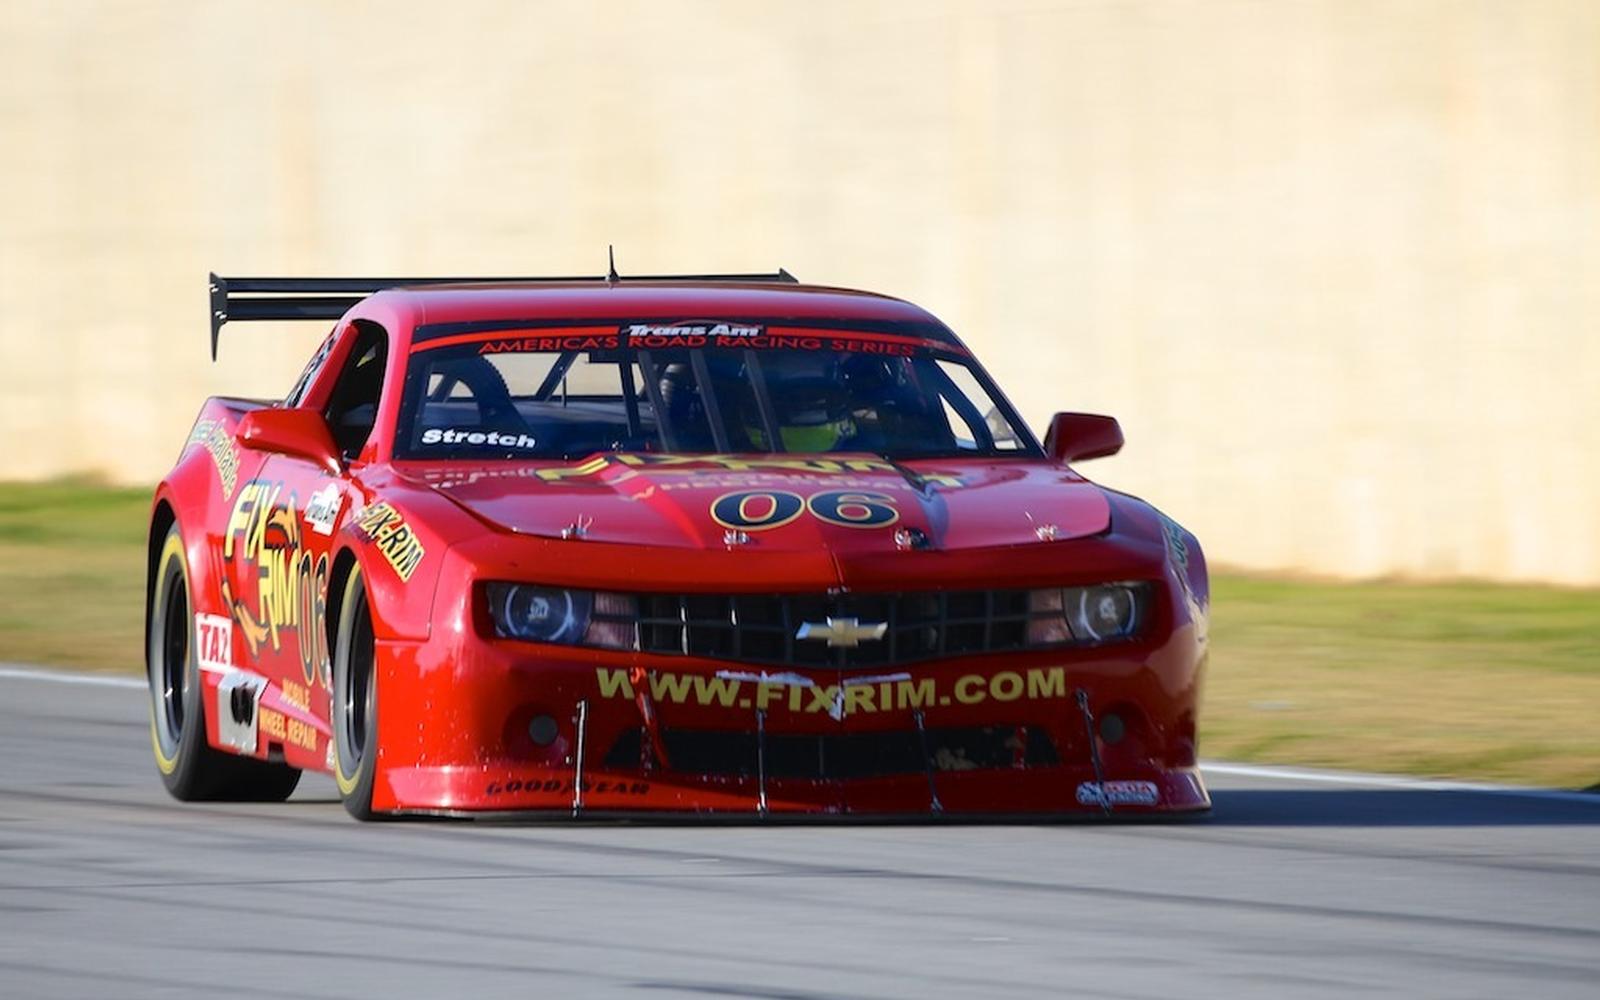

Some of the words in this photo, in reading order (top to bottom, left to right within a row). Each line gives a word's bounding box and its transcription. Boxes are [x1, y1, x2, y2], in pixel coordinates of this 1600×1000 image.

[479, 336, 618, 354] AMERICA'S
[628, 335, 706, 348] ROAD
[716, 336, 821, 349] RACING
[831, 340, 915, 356] SERIES
[627, 323, 704, 336] Trans
[708, 323, 762, 337] Am
[421, 429, 536, 449] Stretch
[224, 481, 282, 558] FIX
[709, 489, 900, 531] 06
[354, 502, 424, 583] FIX-RIM
[200, 624, 228, 664] TA2
[596, 667, 1066, 714] WWW.FIXRIM.COM
